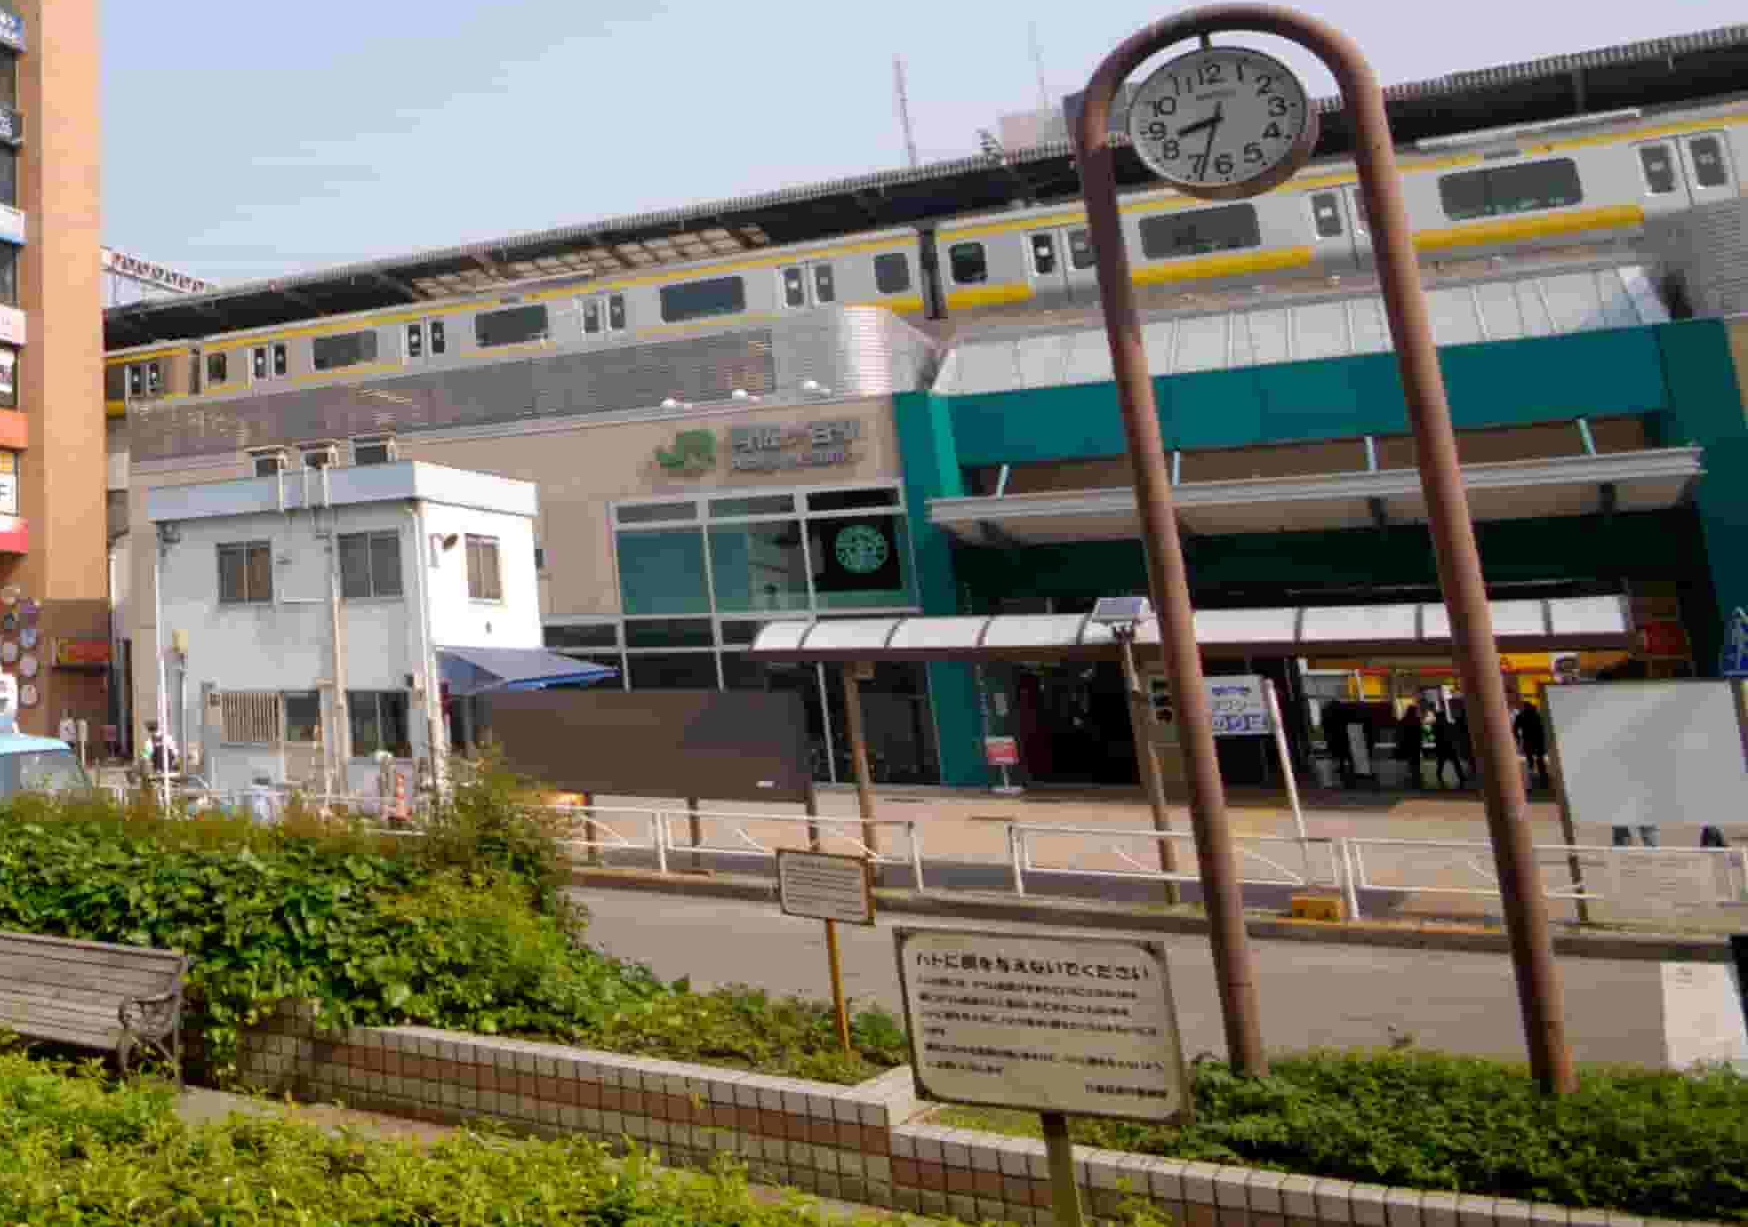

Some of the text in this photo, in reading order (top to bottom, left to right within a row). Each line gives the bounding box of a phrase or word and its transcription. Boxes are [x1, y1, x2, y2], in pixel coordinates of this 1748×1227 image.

[1169, 73, 1192, 95] 11
[1198, 62, 1226, 85] 12
[1255, 74, 1272, 97] 2
[1150, 96, 1177, 117] 10
[1268, 96, 1287, 117] 3
[1148, 122, 1167, 141] 9
[1262, 122, 1280, 140] 4
[1163, 140, 1180, 160] 8
[1244, 142, 1264, 163] 5
[1188, 154, 1203, 174] 7
[1215, 154, 1234, 175] 6
